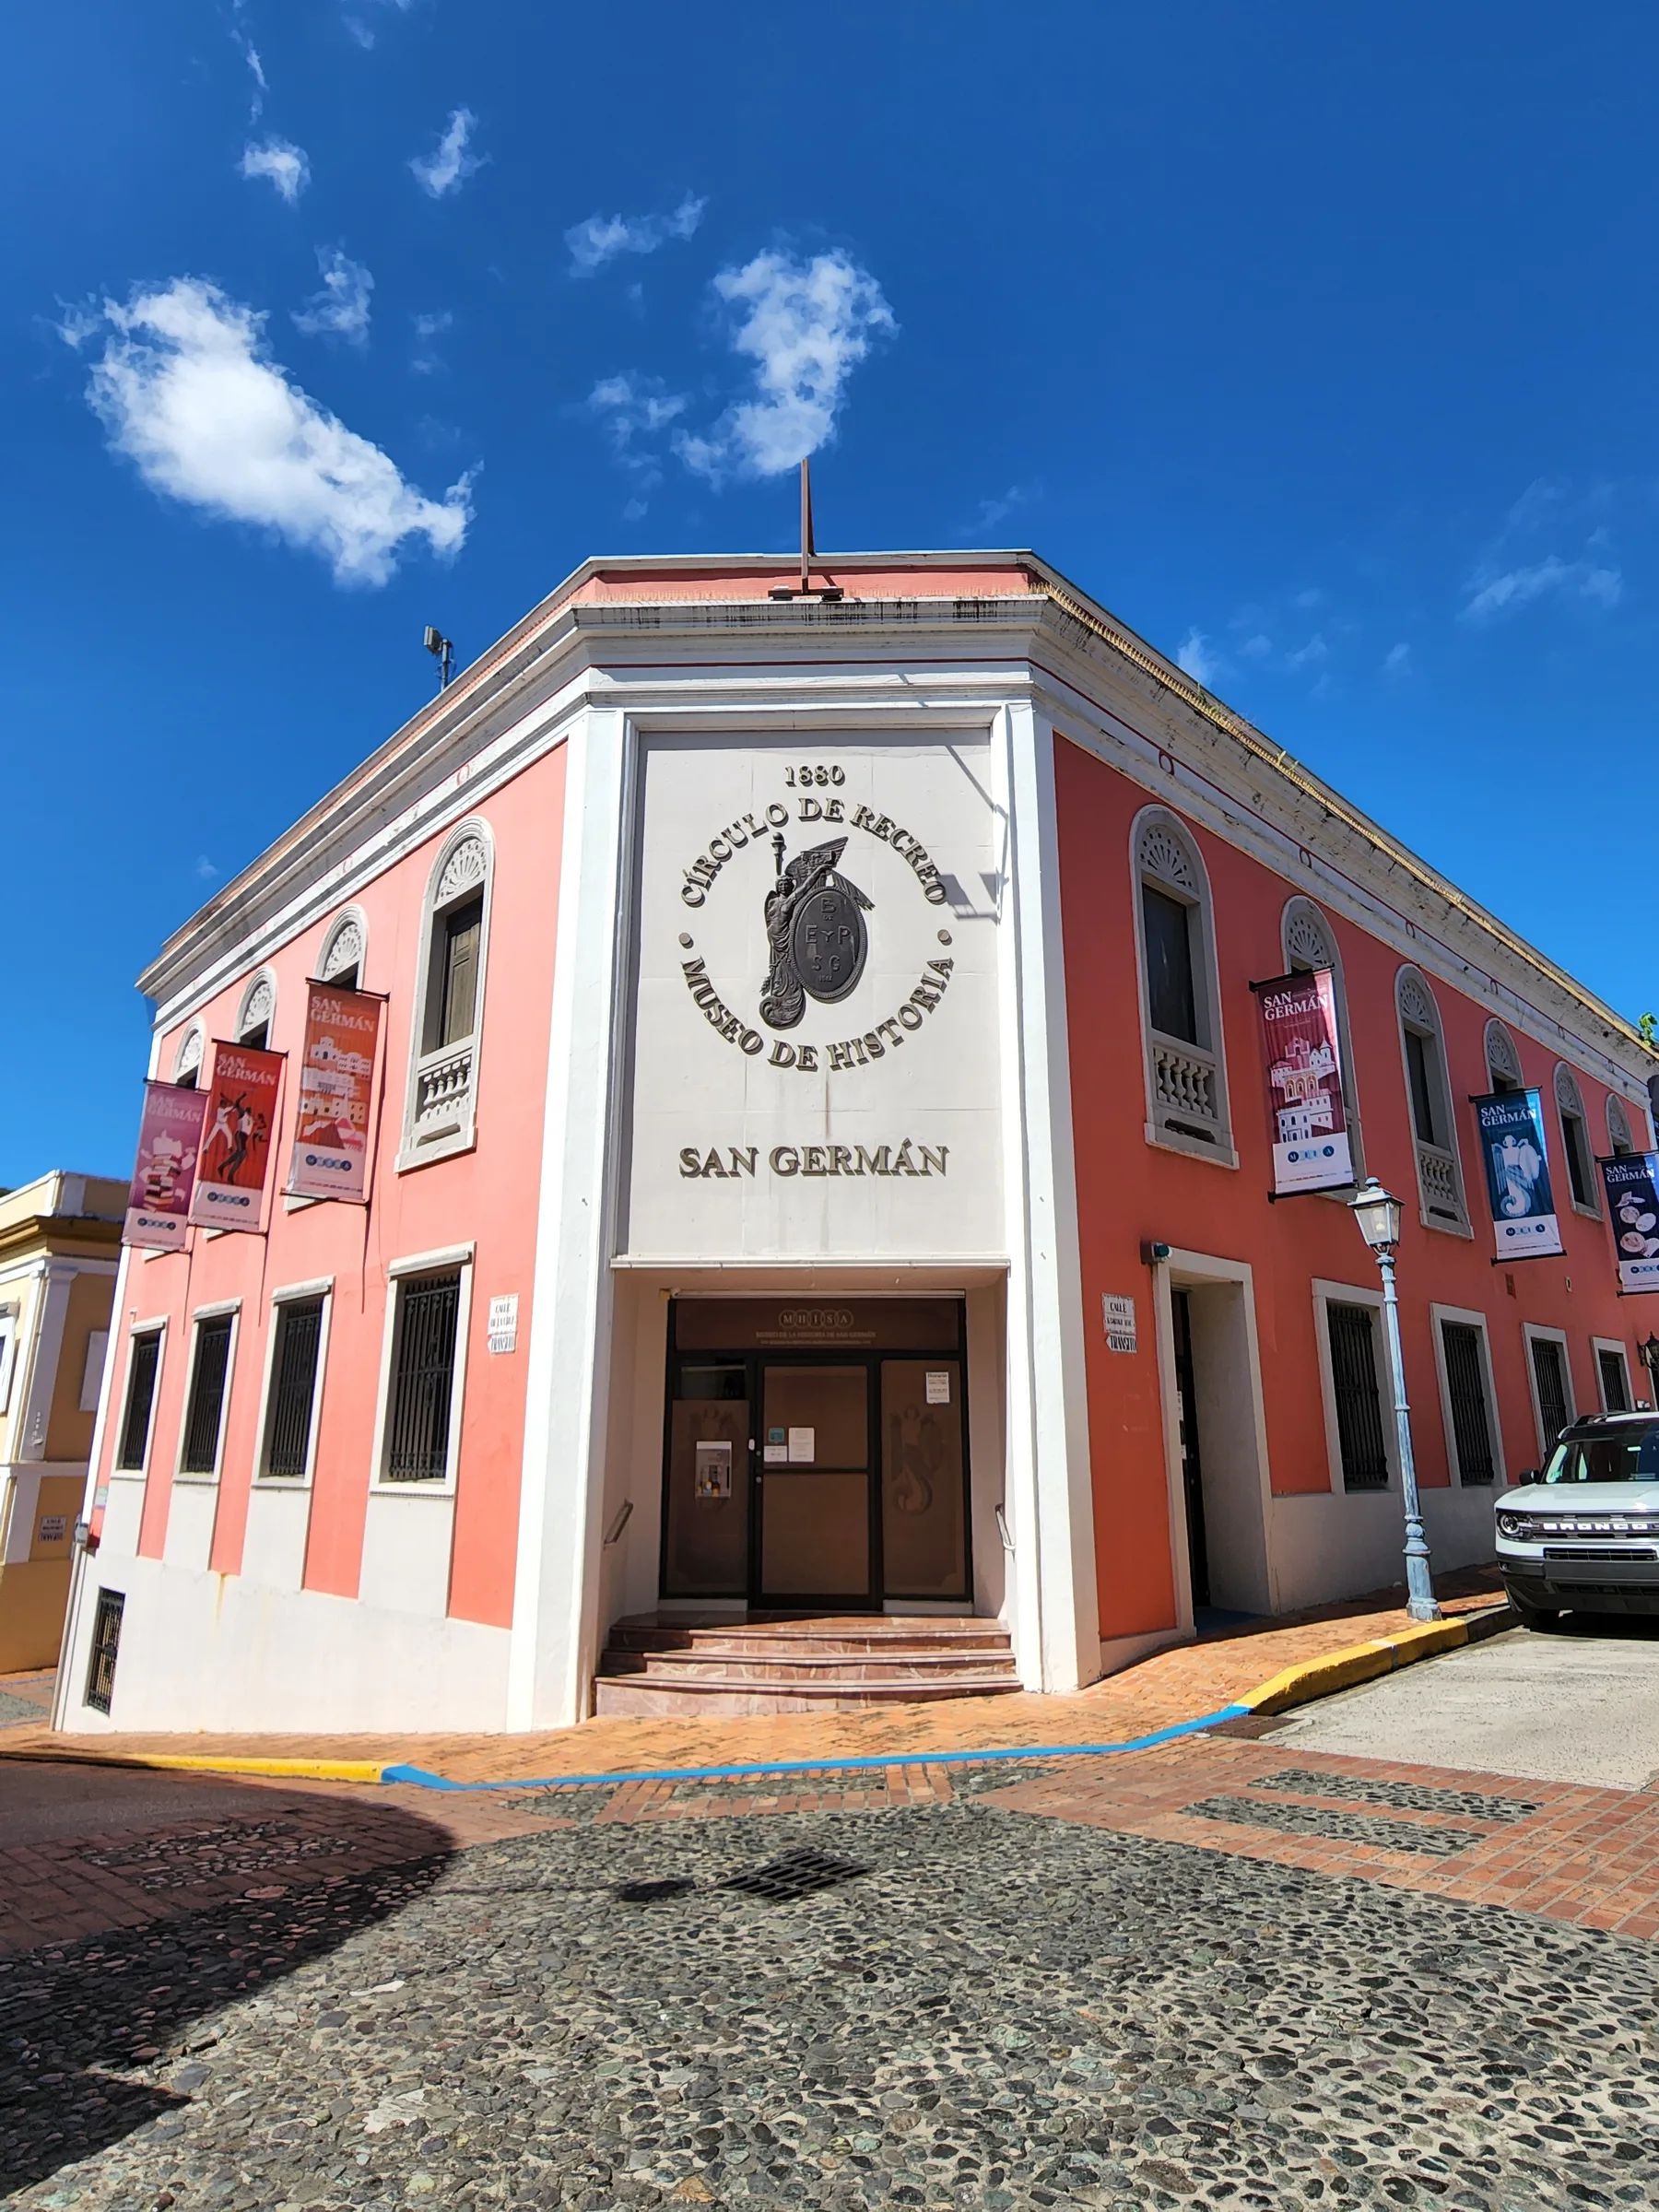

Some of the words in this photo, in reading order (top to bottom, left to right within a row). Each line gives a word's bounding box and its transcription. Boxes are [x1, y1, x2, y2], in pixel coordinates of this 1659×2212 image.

[785, 766, 845, 787] 1880
[681, 803, 789, 908] CÍRCULO
[798, 797, 845, 823] DE
[850, 804, 946, 905] RECREO
[806, 924, 818, 944] E
[838, 924, 852, 945] P
[311, 996, 342, 1012] SAN
[1264, 991, 1291, 1008] SAN
[1265, 994, 1327, 1020] GERMÁN
[311, 1009, 376, 1032] GERMÁN
[680, 955, 764, 1055] MUSEO
[767, 1040, 818, 1072] DE
[826, 958, 954, 1072] HISTORIA
[218, 1053, 247, 1069] SAN
[218, 1065, 276, 1086] GERMÁN
[1480, 1104, 1505, 1117] SAN
[1482, 1108, 1536, 1126] GERMÁN
[679, 1147, 759, 1178] SAN
[769, 1137, 950, 1177] GERMÁN
[1606, 1165, 1627, 1175] SAN
[1606, 1169, 1654, 1182] GERMÁN
[782, 1313, 849, 1324] MHISA
[1543, 1523, 1648, 1531] BRONCO
